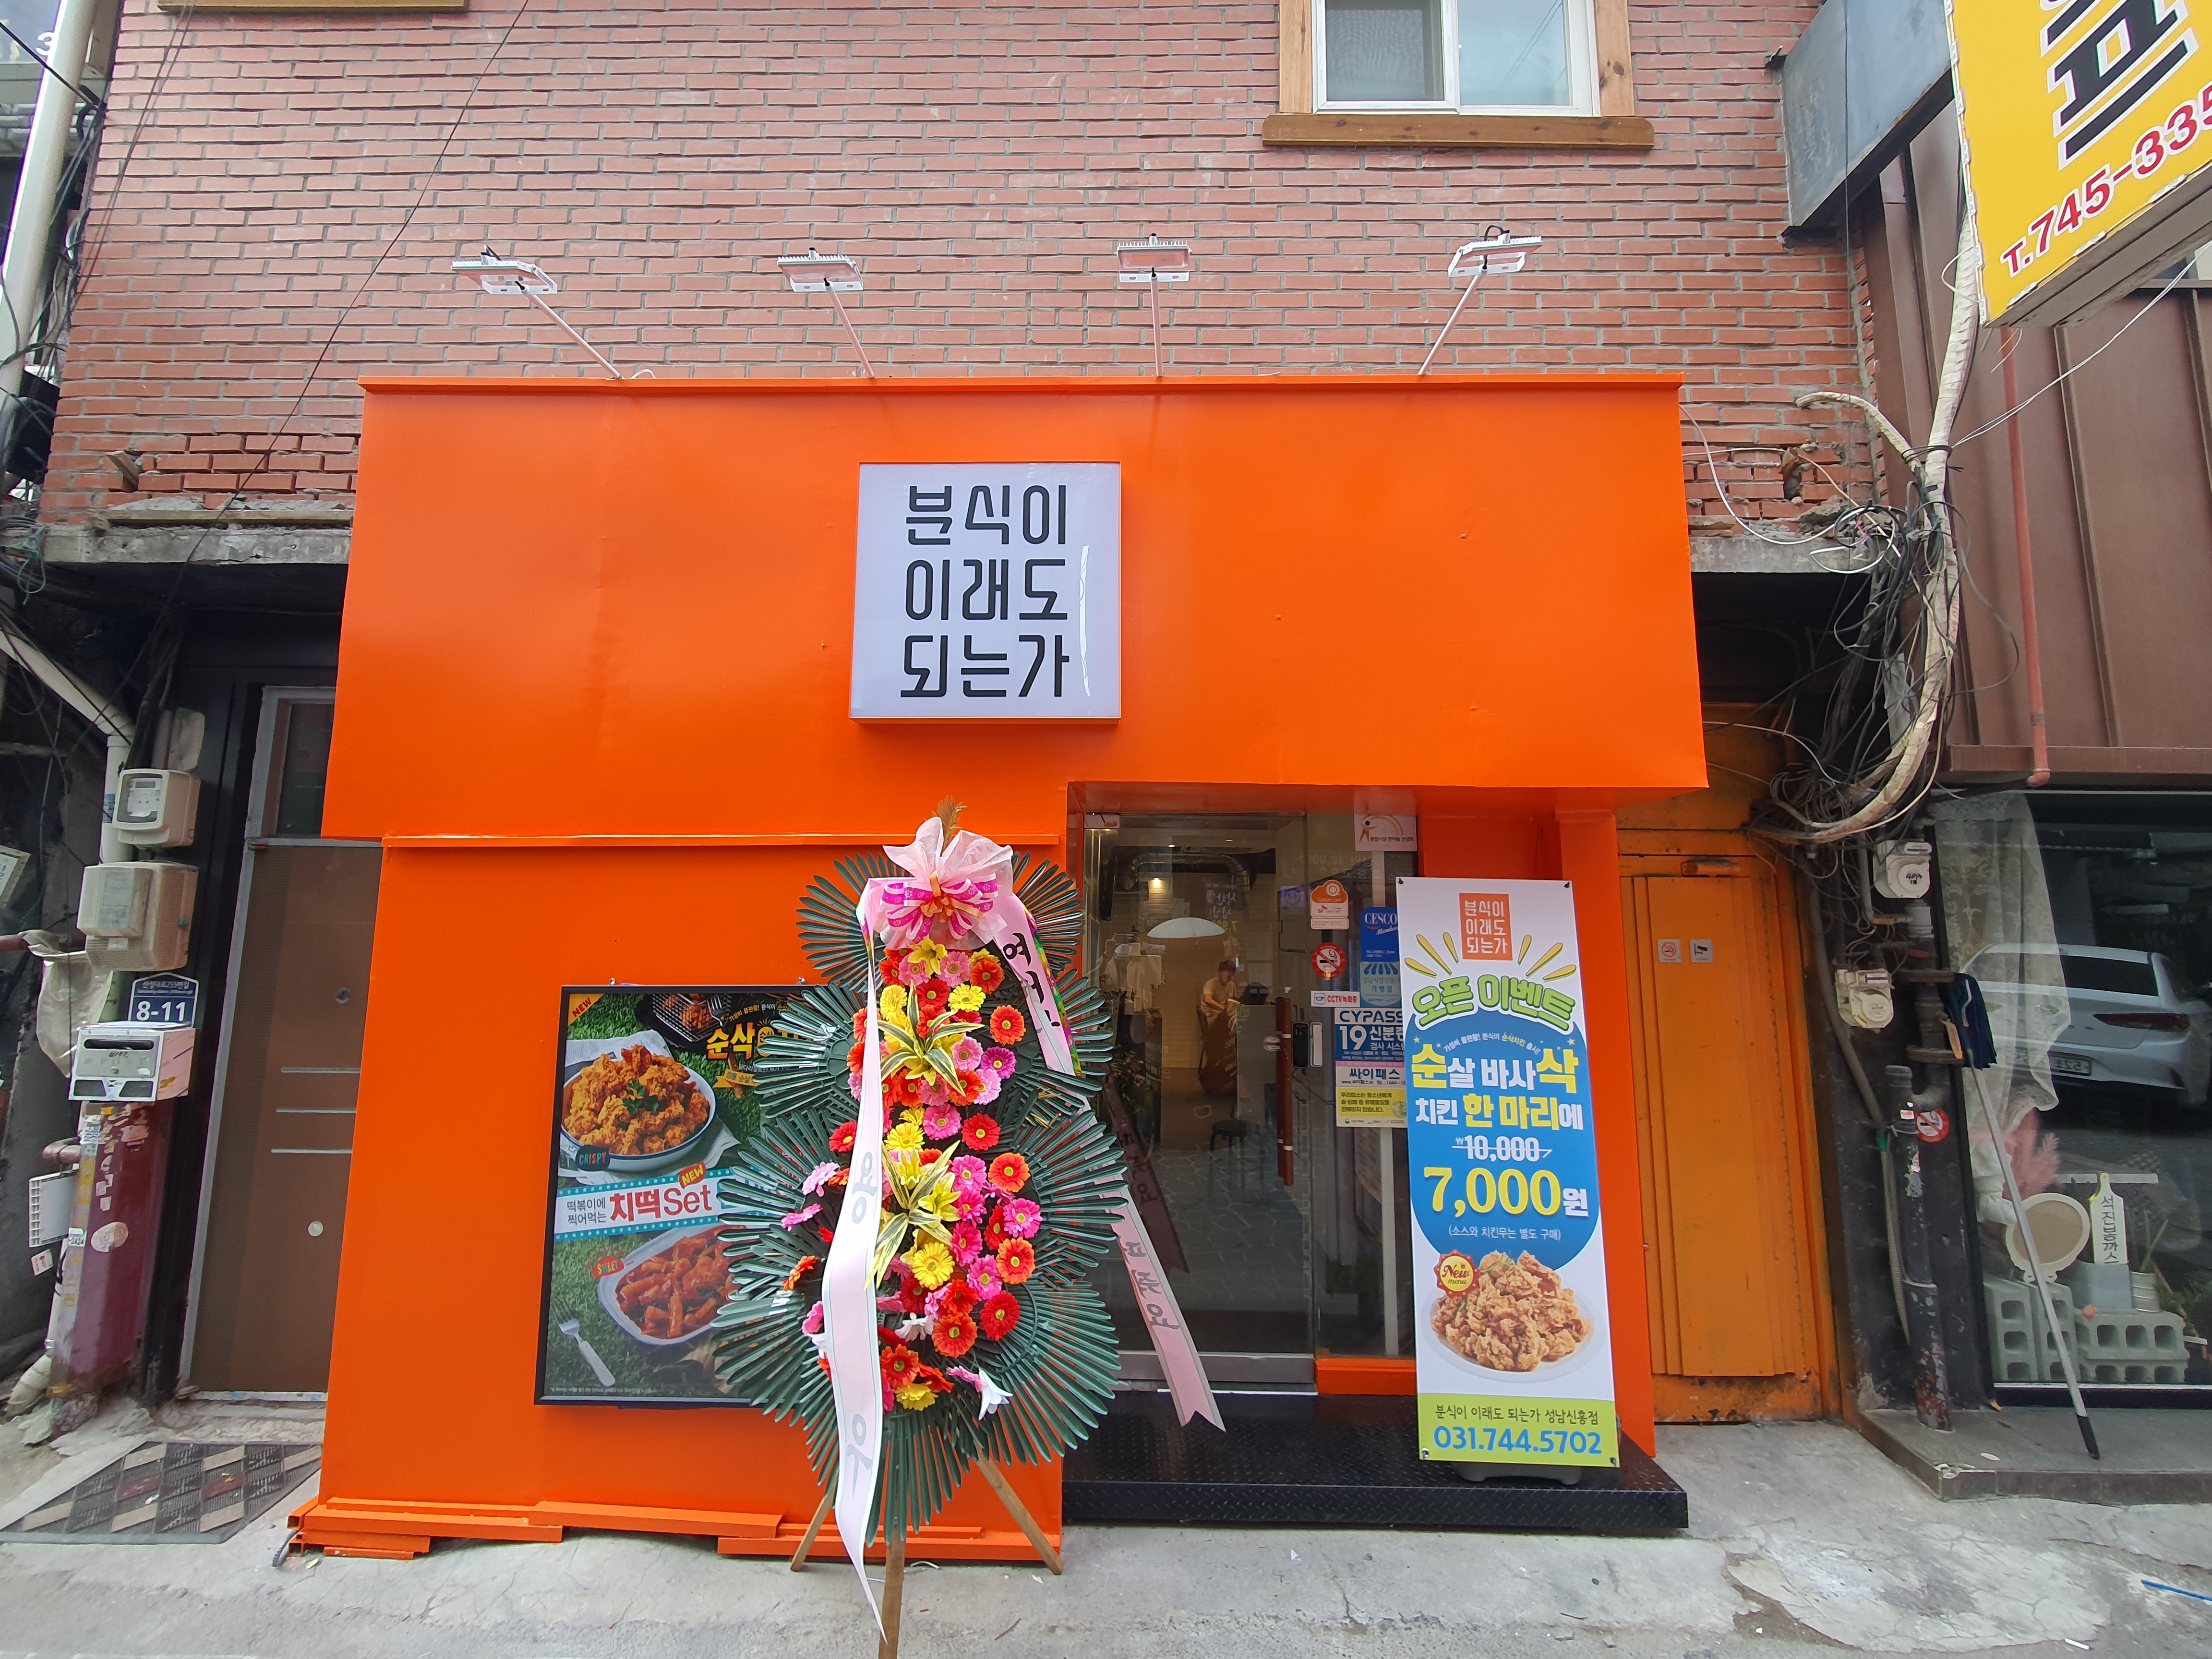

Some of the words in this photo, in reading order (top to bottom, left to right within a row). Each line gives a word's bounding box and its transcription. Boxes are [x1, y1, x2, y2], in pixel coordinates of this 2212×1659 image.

[2047, 0, 2190, 161] 프
[906, 485, 1066, 545] 분식이
[905, 559, 1068, 620] 이래도
[900, 634, 1070, 697] 되는가
[1364, 913, 1397, 925] CESCO
[1464, 900, 1504, 917] 분식이
[1466, 919, 1506, 936] 이래도
[1467, 937, 1507, 954] 되는가
[136, 1001, 186, 1022] 8-11
[572, 997, 591, 1018] NEW
[1412, 975, 1475, 1027] 오픈
[1477, 974, 1576, 1032] 이벤트
[1339, 1010, 1403, 1023] CYPASS
[706, 1022, 756, 1060] 순삭
[1339, 1025, 1367, 1050] 19
[1369, 1026, 1404, 1042] 신분증
[1370, 1042, 1385, 1051] 검사
[1349, 1068, 1400, 1080] 싸이패스
[1411, 1044, 1476, 1089] 순살
[1480, 1047, 1579, 1094] 바사삭
[1415, 1098, 1459, 1125] 치킨
[1463, 1093, 1494, 1128] 한
[1499, 1096, 1584, 1131] 마리에
[578, 1152, 606, 1165] CRISPY
[681, 1164, 704, 1186] NEW
[609, 1184, 712, 1222] 치떡Set
[1423, 1167, 1589, 1218] 7,000원
[567, 1197, 606, 1212] 떡볶이에
[567, 1212, 607, 1226] 찍어먹는
[1448, 1225, 1479, 1238] (소스와
[1481, 1226, 1517, 1238] 치킨무는
[1519, 1227, 1538, 1240] 별도
[1539, 1228, 1562, 1241] 구매)
[597, 1260, 618, 1275] SWEET
[1441, 1264, 1471, 1278] New
[1434, 1405, 1467, 1420] 분식이
[1471, 1406, 1504, 1420] 이래도
[1508, 1408, 1541, 1423] 되는가
[1545, 1409, 1599, 1425] 성남신흥점
[1433, 1425, 1603, 1455] 031.744.5702
